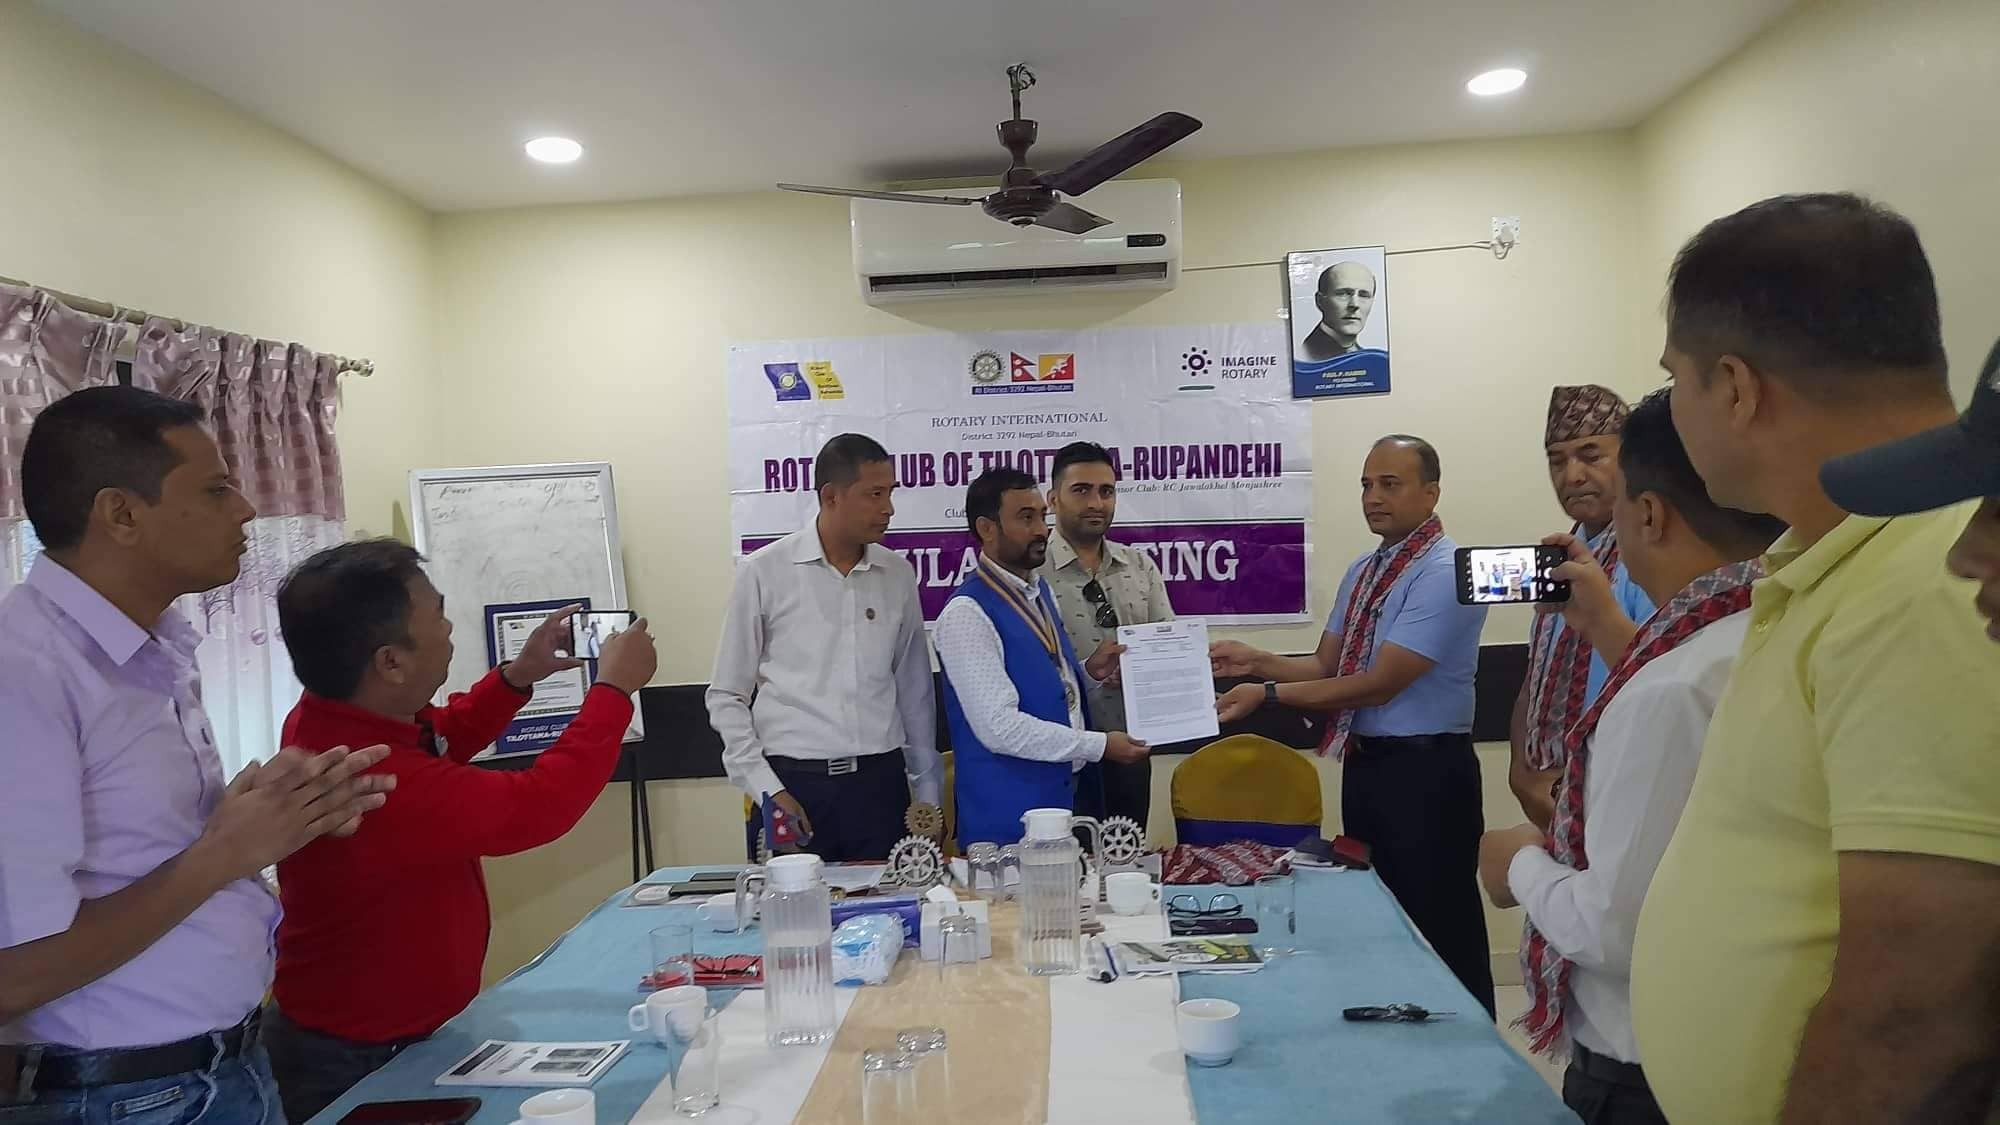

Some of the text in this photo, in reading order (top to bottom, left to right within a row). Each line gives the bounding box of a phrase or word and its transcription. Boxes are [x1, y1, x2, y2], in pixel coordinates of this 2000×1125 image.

[1221, 356, 1277, 367] IMAGINE
[1222, 368, 1268, 379] ROTARY
[932, 412, 1108, 428] ROTARY INTERNATIONAL
[962, 430, 1078, 441] District 3292 Nepal-Bhutan
[764, 457, 814, 493] ROT
[889, 453, 936, 488] LUB
[943, 451, 972, 487] OF
